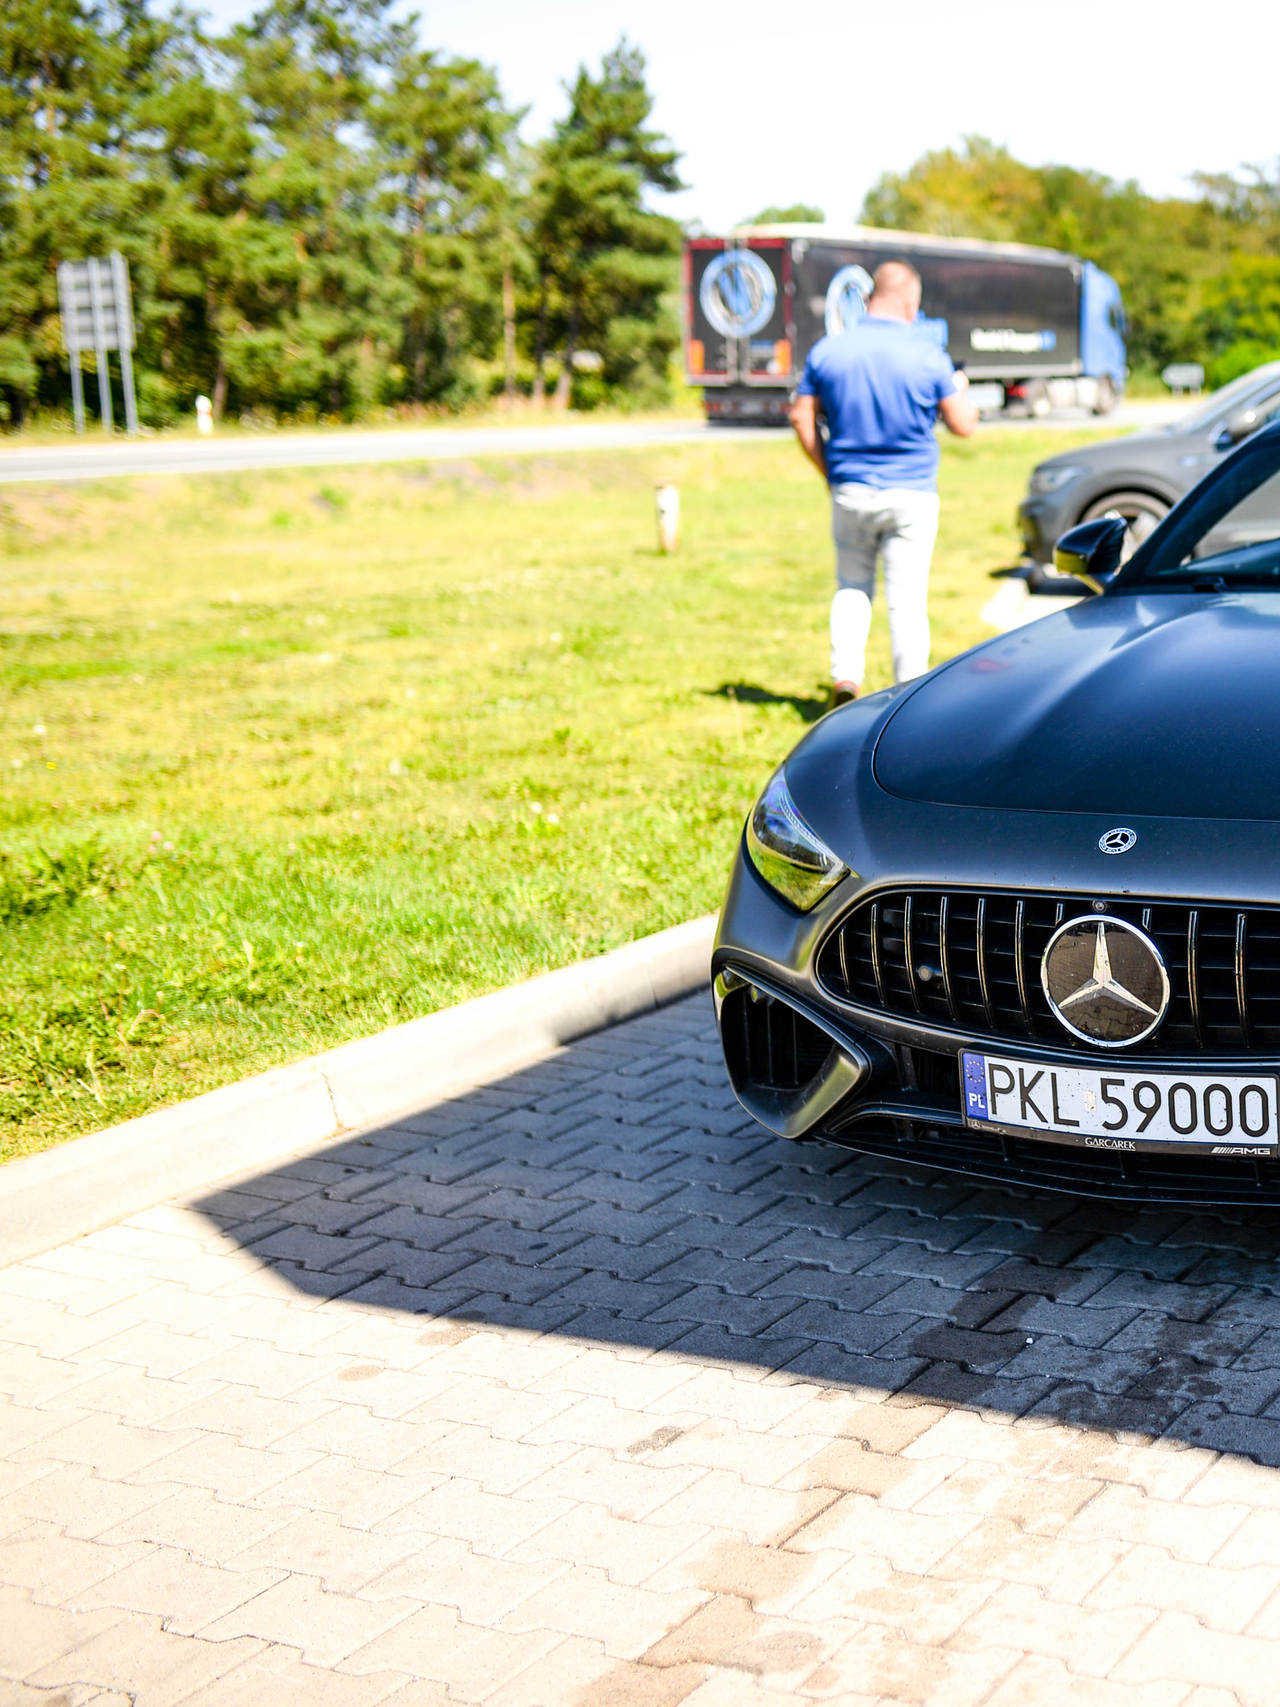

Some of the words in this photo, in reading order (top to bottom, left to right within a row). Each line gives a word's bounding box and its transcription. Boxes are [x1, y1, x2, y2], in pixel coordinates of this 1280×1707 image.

[969, 1093, 986, 1109] PL
[988, 1062, 1080, 1127] PKL
[1100, 1077, 1270, 1137] 59000
[1084, 1137, 1136, 1150] GARCAREK
